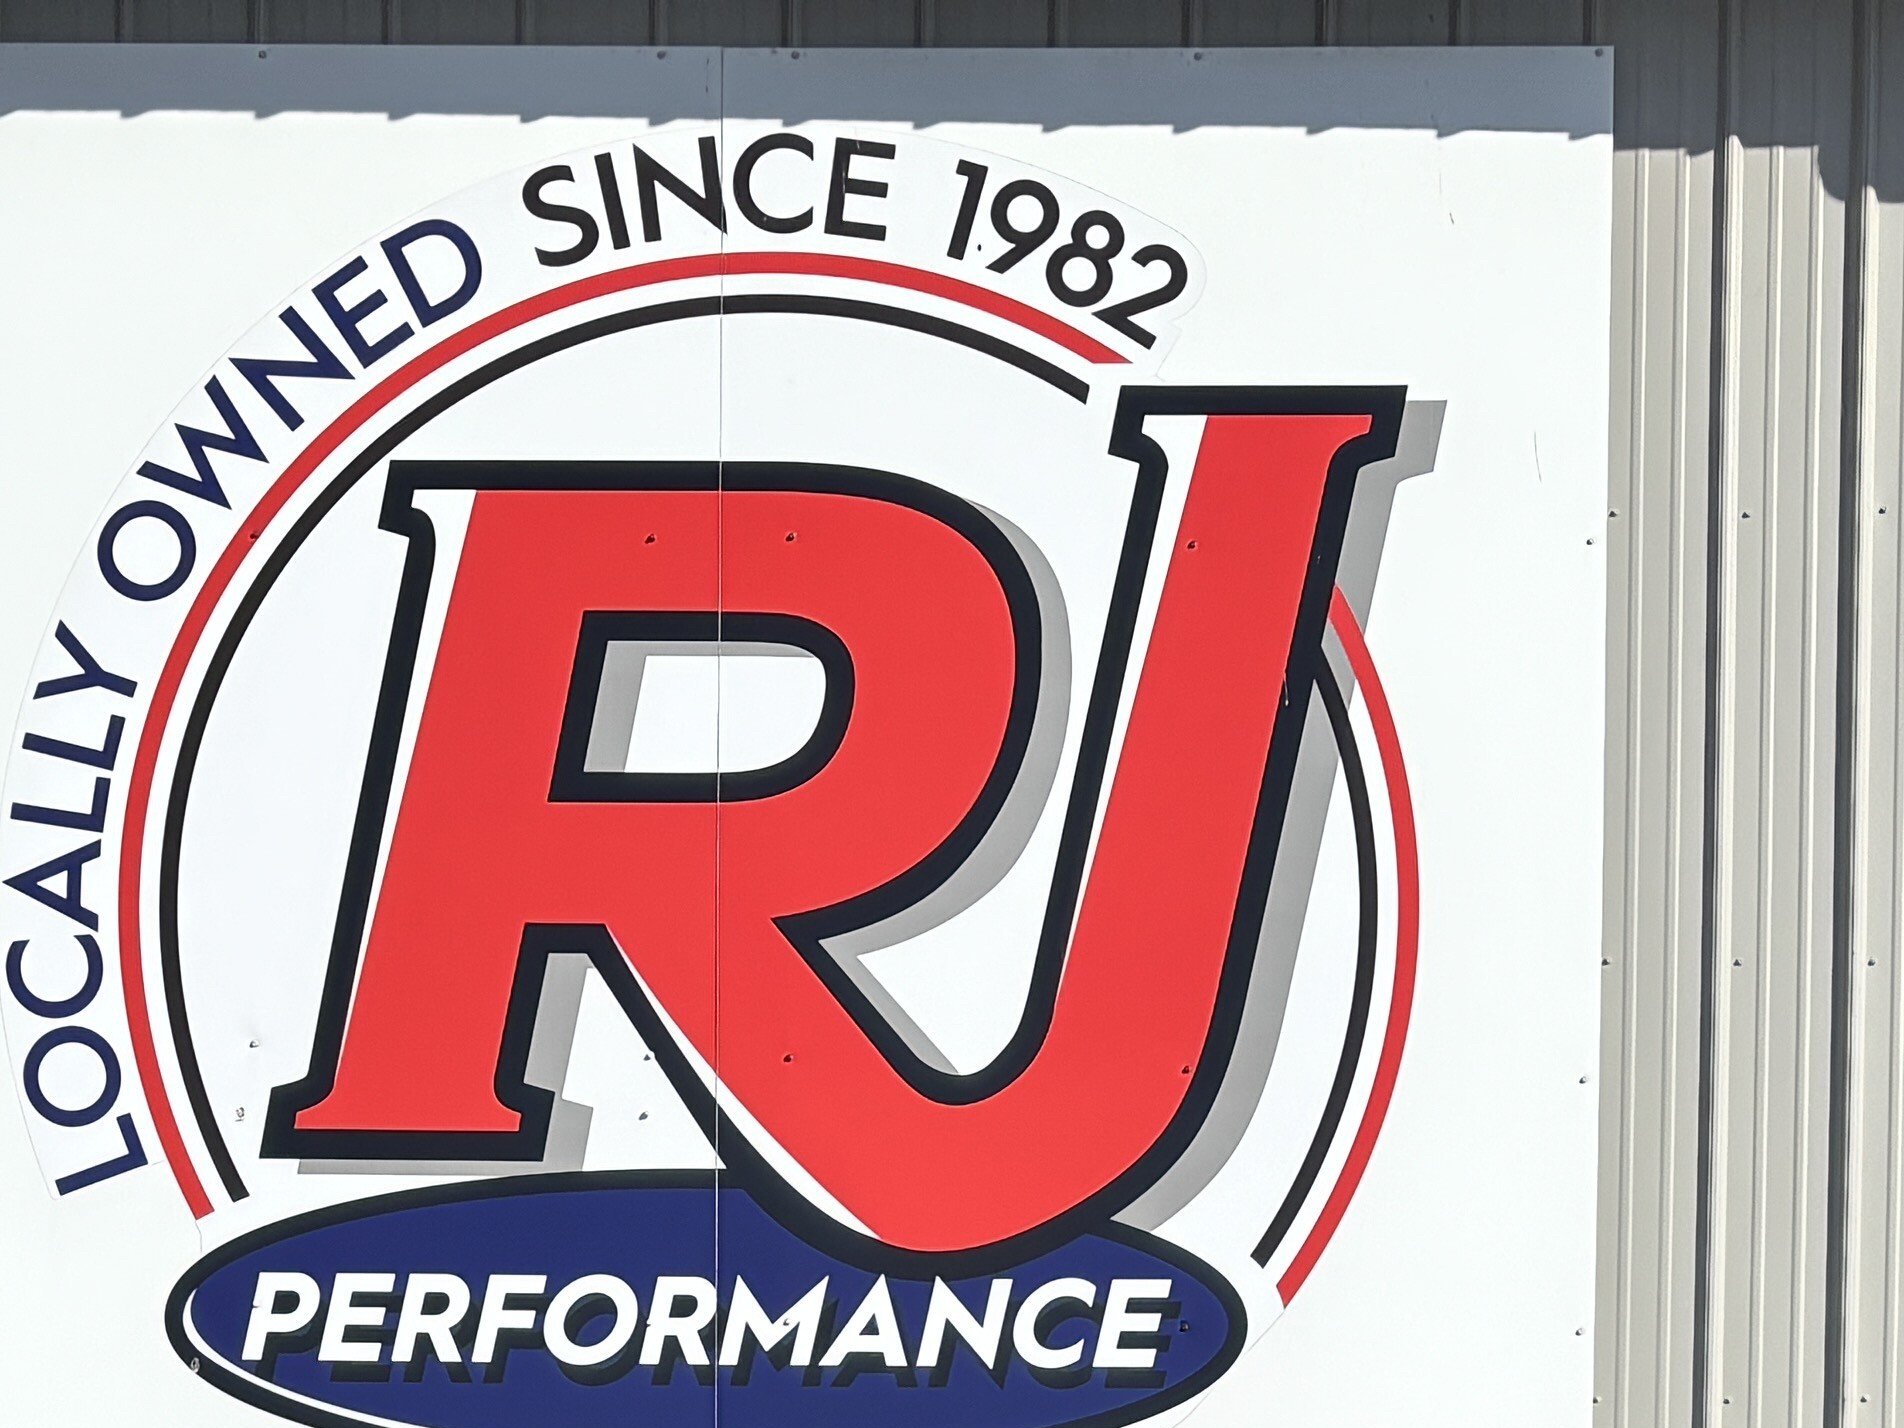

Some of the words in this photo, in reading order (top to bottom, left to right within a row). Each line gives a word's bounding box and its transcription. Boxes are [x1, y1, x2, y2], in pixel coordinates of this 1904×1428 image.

[3, 620, 148, 1195] LOCALLY
[98, 220, 482, 601] OWNED
[523, 133, 895, 266] SINCE
[947, 160, 1187, 349] 1982
[261, 385, 1407, 1278] RJ
[242, 1272, 1171, 1369] PERFORMANCE
